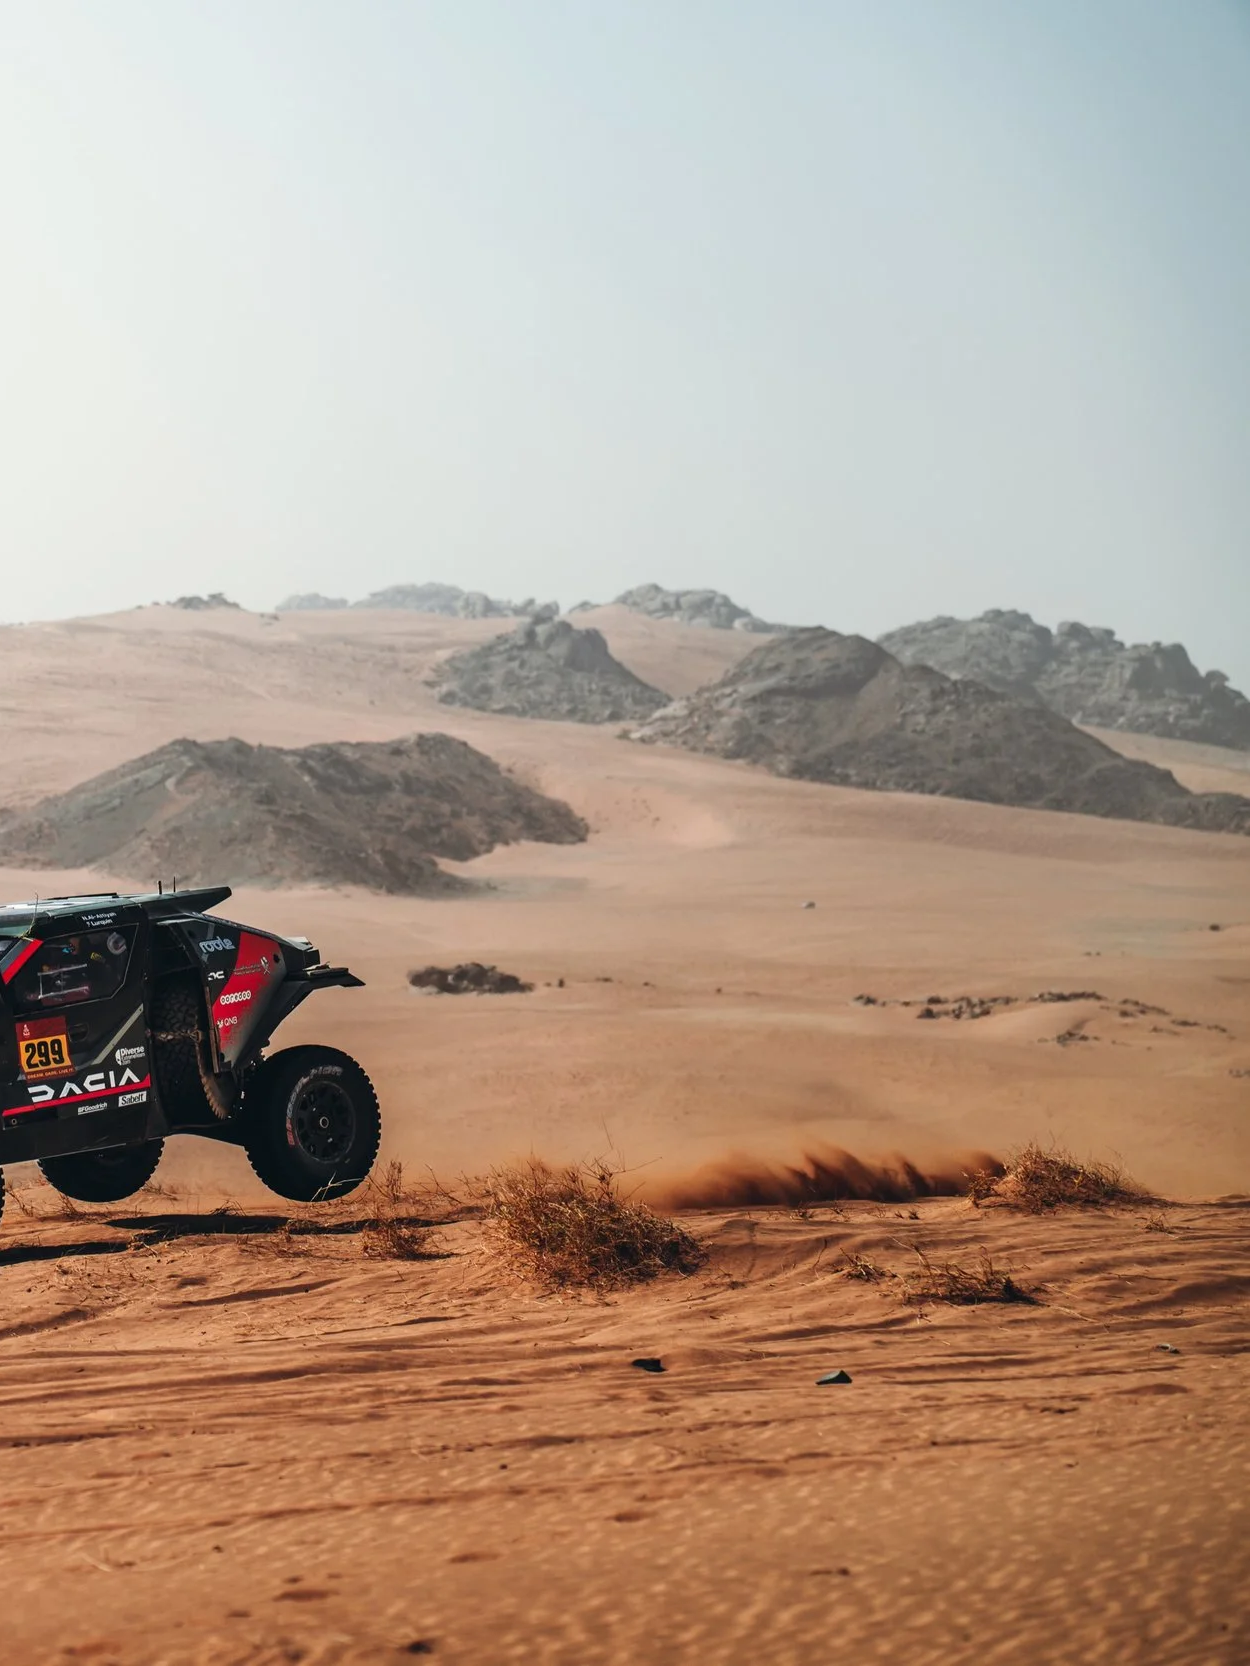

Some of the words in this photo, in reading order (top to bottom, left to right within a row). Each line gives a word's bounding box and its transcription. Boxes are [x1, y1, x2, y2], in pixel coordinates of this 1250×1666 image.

[220, 990, 251, 1005] ooredoo
[224, 1016, 238, 1026] QNB
[25, 1039, 64, 1068] 299
[120, 1046, 144, 1056] Diverse
[28, 1068, 140, 1103] DACIA
[121, 1094, 144, 1105] Sabelt
